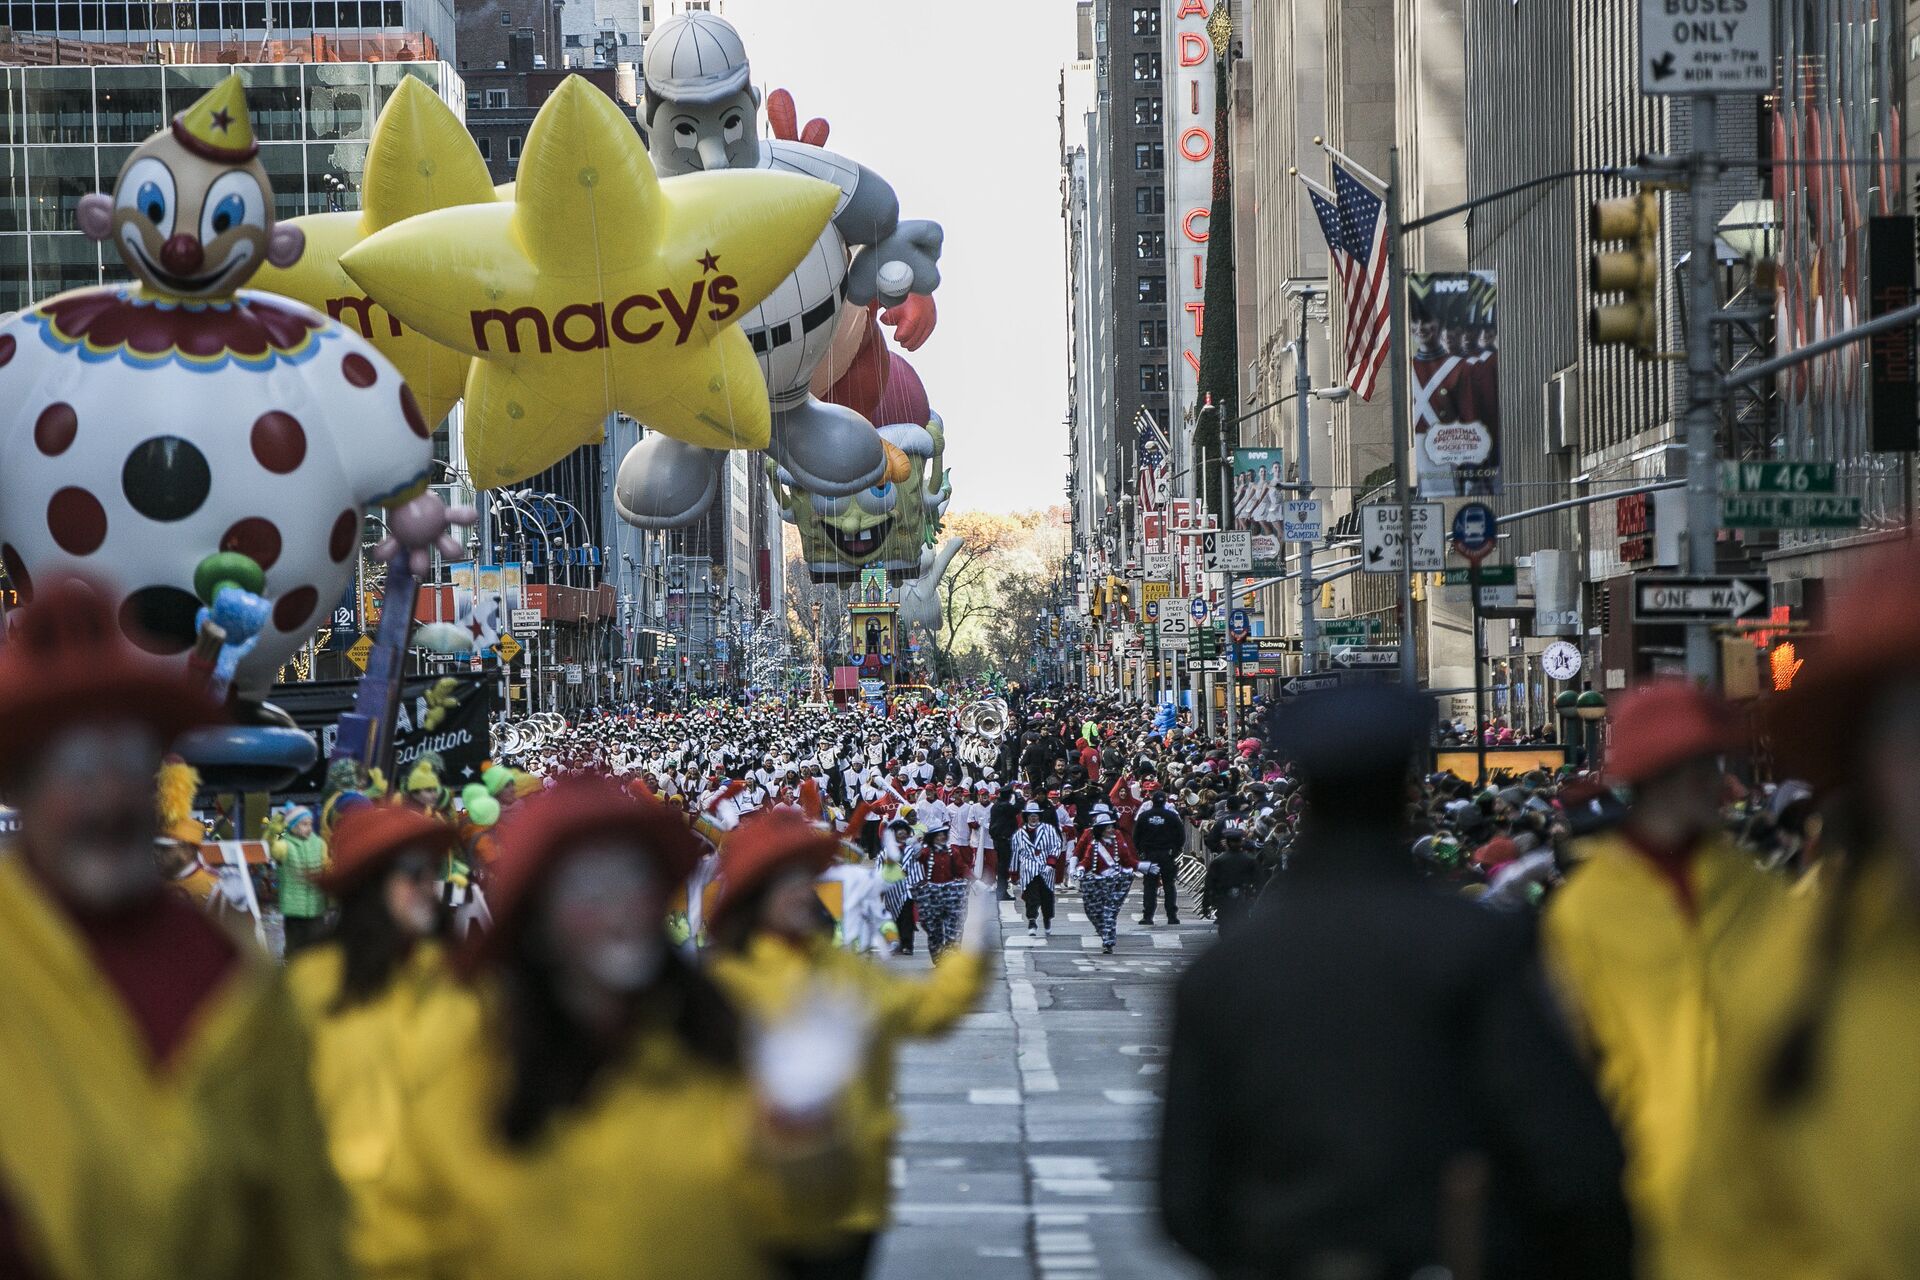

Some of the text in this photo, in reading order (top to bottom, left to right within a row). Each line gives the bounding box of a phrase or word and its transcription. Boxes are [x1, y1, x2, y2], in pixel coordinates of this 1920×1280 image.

[1674, 21, 1738, 43] ONLY
[1684, 68, 1713, 80] MON
[1746, 65, 1767, 79] FRI
[1434, 280, 1469, 293] NYC
[1437, 428, 1478, 438] CHRISTMAS
[1437, 443, 1479, 452] ROCKETTES
[1248, 451, 1268, 460] NYC
[1745, 466, 1763, 490] W
[1775, 466, 1809, 490] 46
[1289, 502, 1316, 511] NYPD
[1725, 497, 1857, 517] LITTLE BRAZIL
[1285, 521, 1321, 531] SECURITY
[1221, 534, 1246, 543] BUSES
[1286, 530, 1319, 539] CAMERA
[1384, 532, 1423, 546] ONY
[1223, 548, 1243, 557] ONLY
[1428, 558, 1441, 566] FRI
[1655, 590, 1752, 608] ONE WAY
[1539, 611, 1579, 625] 1212
[1163, 619, 1186, 633] 25
[1260, 640, 1287, 649] Subway
[1341, 651, 1393, 663] ONE WAY
[1289, 678, 1337, 690] ONE WAY
[393, 728, 472, 765] radition
